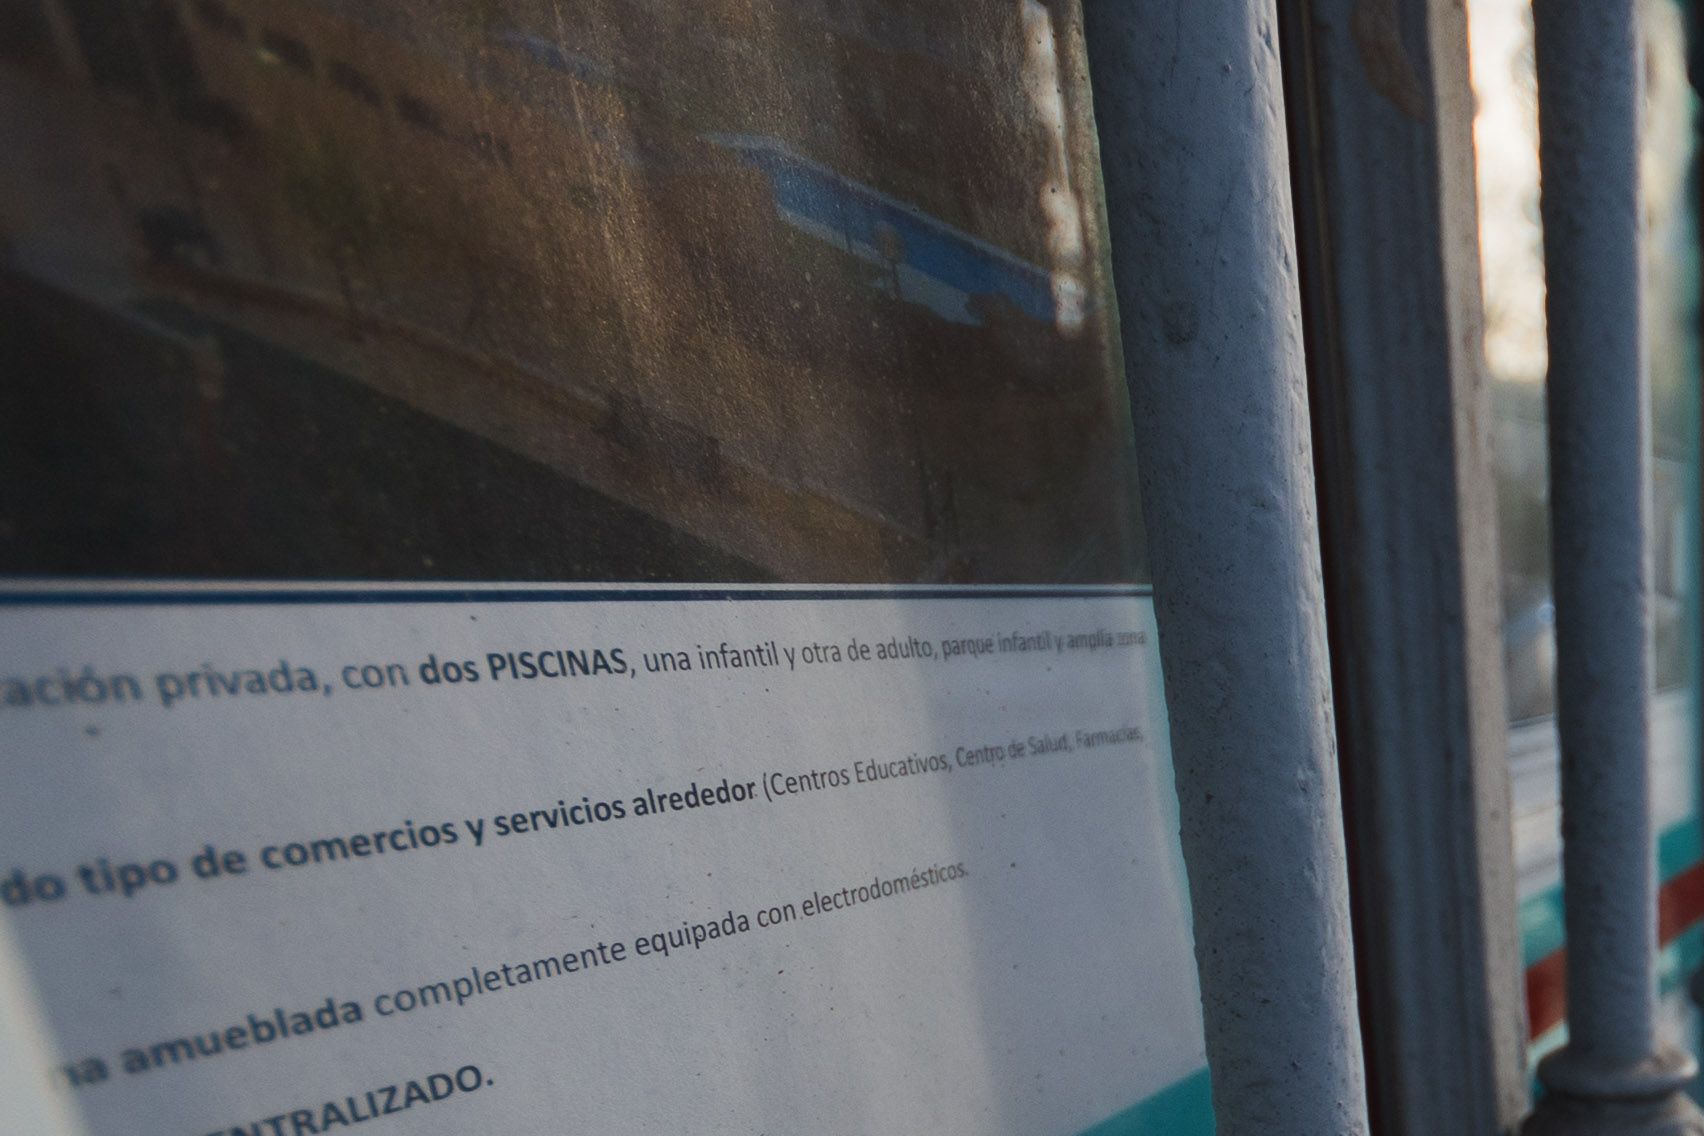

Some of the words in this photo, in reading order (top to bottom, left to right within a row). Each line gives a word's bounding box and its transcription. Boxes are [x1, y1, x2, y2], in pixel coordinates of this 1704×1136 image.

[155, 657, 333, 708] privada,
[342, 662, 410, 689] con
[419, 654, 480, 685] dos
[487, 648, 636, 680] PISCINAS,
[643, 651, 692, 673] una
[696, 641, 779, 670] infantil
[783, 647, 796, 671] y
[802, 641, 842, 665] otra
[847, 638, 871, 662] de
[877, 635, 939, 661] adulto,
[942, 636, 994, 663] parque
[997, 630, 1050, 654] infantil
[77, 856, 179, 898] tipo
[192, 843, 247, 879] de
[261, 820, 458, 869] comercios
[465, 818, 485, 847] y
[494, 797, 627, 836] servicios
[634, 778, 756, 816] alrededor
[763, 766, 850, 802] (Centros
[854, 751, 953, 784] Educativos,
[956, 743, 1004, 768] Centro
[1008, 737, 1025, 760] de
[1028, 733, 1071, 756] Salud,
[121, 998, 364, 1074] amueblada
[375, 938, 627, 1017] completamente
[634, 910, 751, 957] equipada
[757, 902, 797, 928] con
[802, 861, 969, 917] electrodomésticos.
